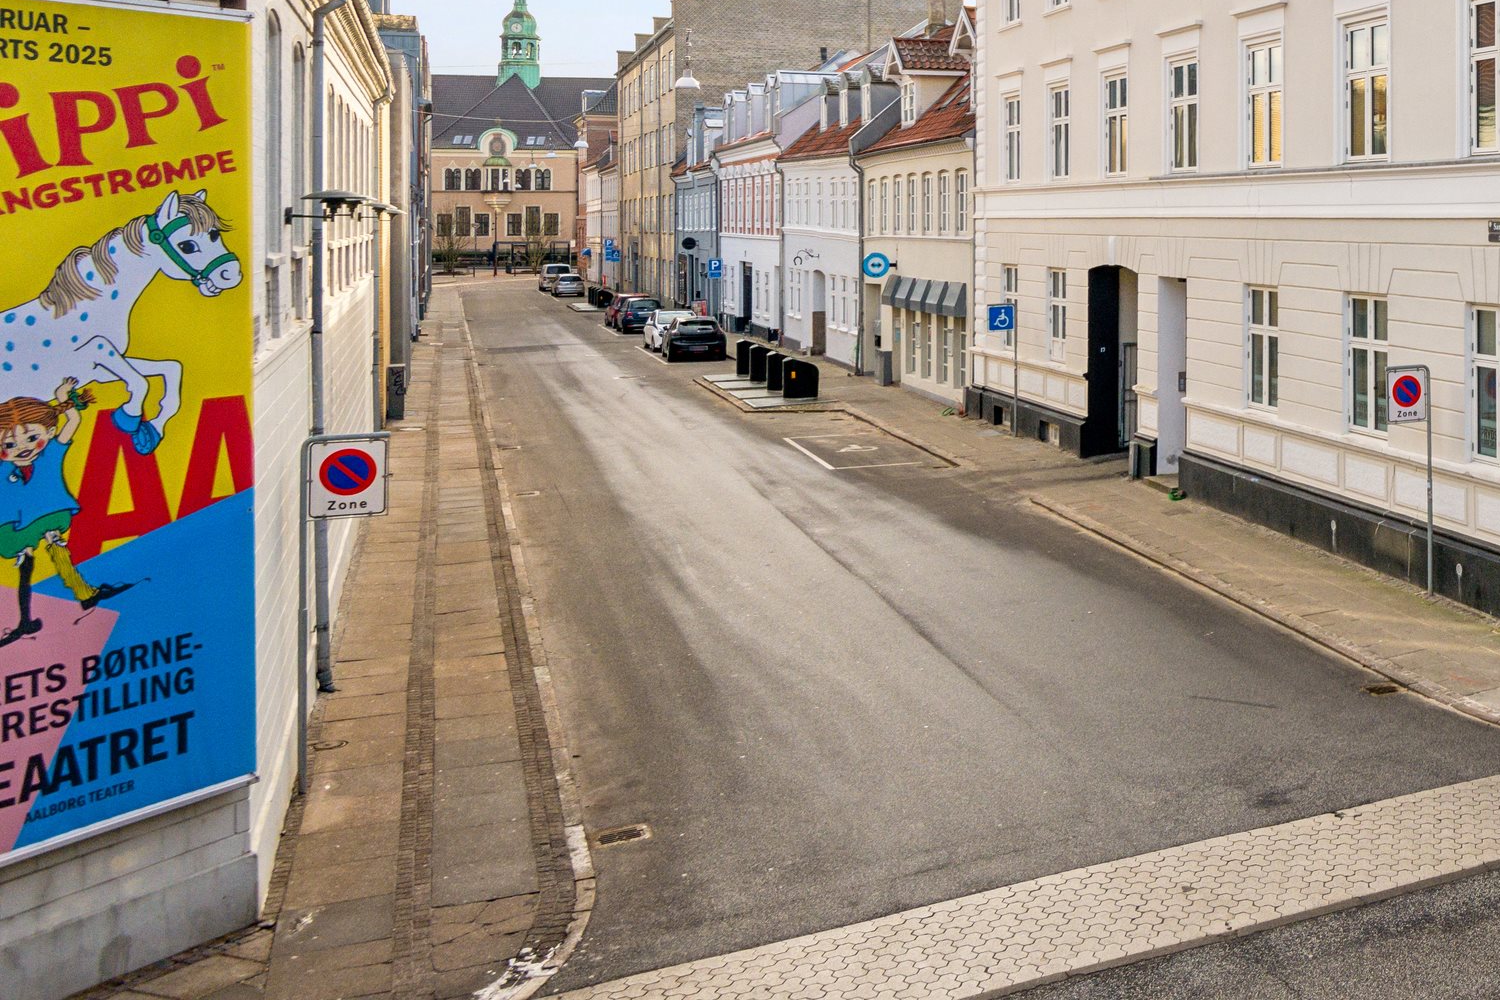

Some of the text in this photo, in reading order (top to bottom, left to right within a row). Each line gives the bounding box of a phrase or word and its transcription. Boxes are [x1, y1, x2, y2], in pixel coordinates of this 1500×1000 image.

[48, 42, 113, 66] 2025
[0, 150, 237, 215] NGSTRØMPE
[1397, 410, 1418, 418] Zone
[327, 500, 368, 511] Zone
[0, 632, 204, 707] ETS BØRNE-
[2, 667, 195, 743] RESTILLING
[24, 780, 135, 825] AALBORG TEATER
